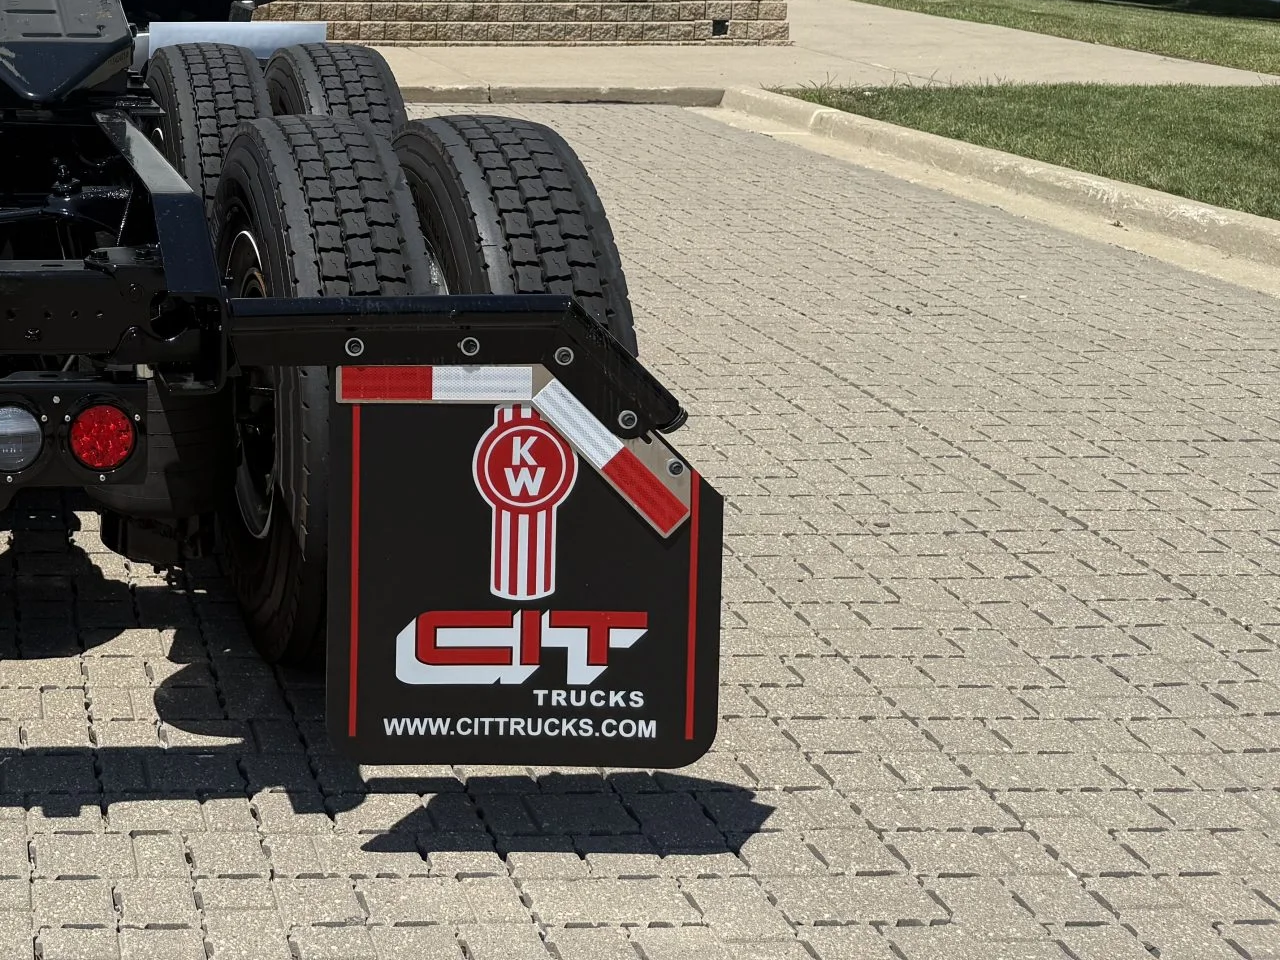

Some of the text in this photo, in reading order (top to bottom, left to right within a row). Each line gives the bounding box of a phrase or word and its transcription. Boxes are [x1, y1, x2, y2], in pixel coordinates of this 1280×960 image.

[396, 609, 648, 684] CIT
[533, 689, 645, 707] TRUCKS
[383, 717, 657, 739] WWW.CITTRUCKS.COM
